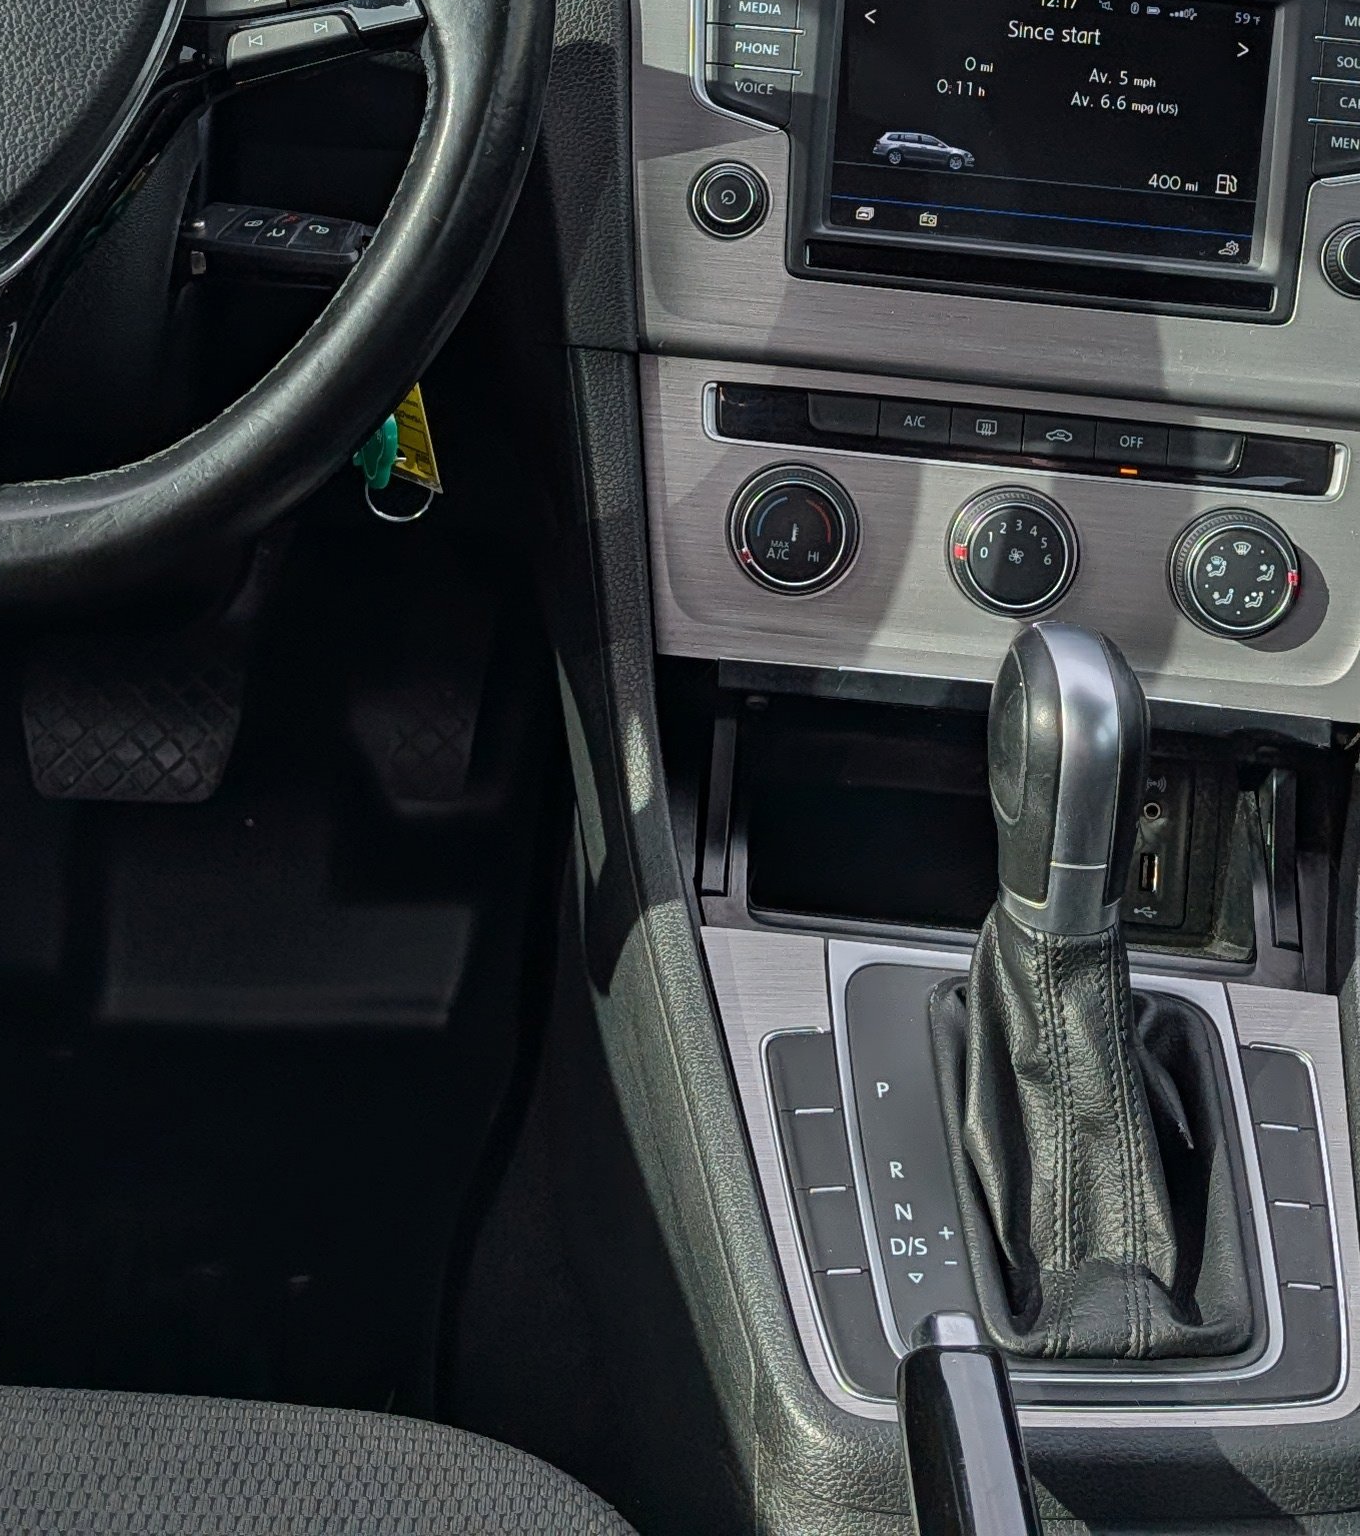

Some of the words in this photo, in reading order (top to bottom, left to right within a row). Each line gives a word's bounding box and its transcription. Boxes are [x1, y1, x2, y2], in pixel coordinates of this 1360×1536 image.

[738, 1, 781, 15] MEDIA
[1234, 12, 1250, 24] 59
[1008, 20, 1055, 41] Since
[1061, 26, 1101, 45] start
[735, 41, 780, 56] PHONE
[965, 56, 976, 71] 0
[980, 62, 993, 73] mi
[1089, 67, 1112, 84] Av.
[1118, 70, 1128, 85] 5
[1133, 76, 1156, 89] mph
[734, 81, 775, 95] VOICE
[936, 78, 973, 96] 0:11
[978, 86, 985, 97] h
[1070, 91, 1094, 108] Av.
[1100, 94, 1127, 110] 6.6
[1131, 101, 1154, 114] mpg
[1156, 102, 1179, 116] (US)
[1148, 173, 1181, 190] 400
[1185, 181, 1198, 192] mi
[903, 414, 926, 428] A/C
[1120, 435, 1144, 448] OFF
[1000, 522, 1007, 534] 2
[1015, 519, 1023, 531] 3
[1029, 525, 1038, 537] 4
[988, 531, 993, 543] 1
[1040, 537, 1048, 549] 5
[766, 548, 790, 560] A/C
[807, 550, 820, 562] HI
[980, 547, 989, 559] 0
[1043, 554, 1052, 565] 6
[875, 1081, 889, 1098] P
[890, 1161, 905, 1178] R
[894, 1203, 913, 1221] N
[890, 1236, 928, 1257] D/S
